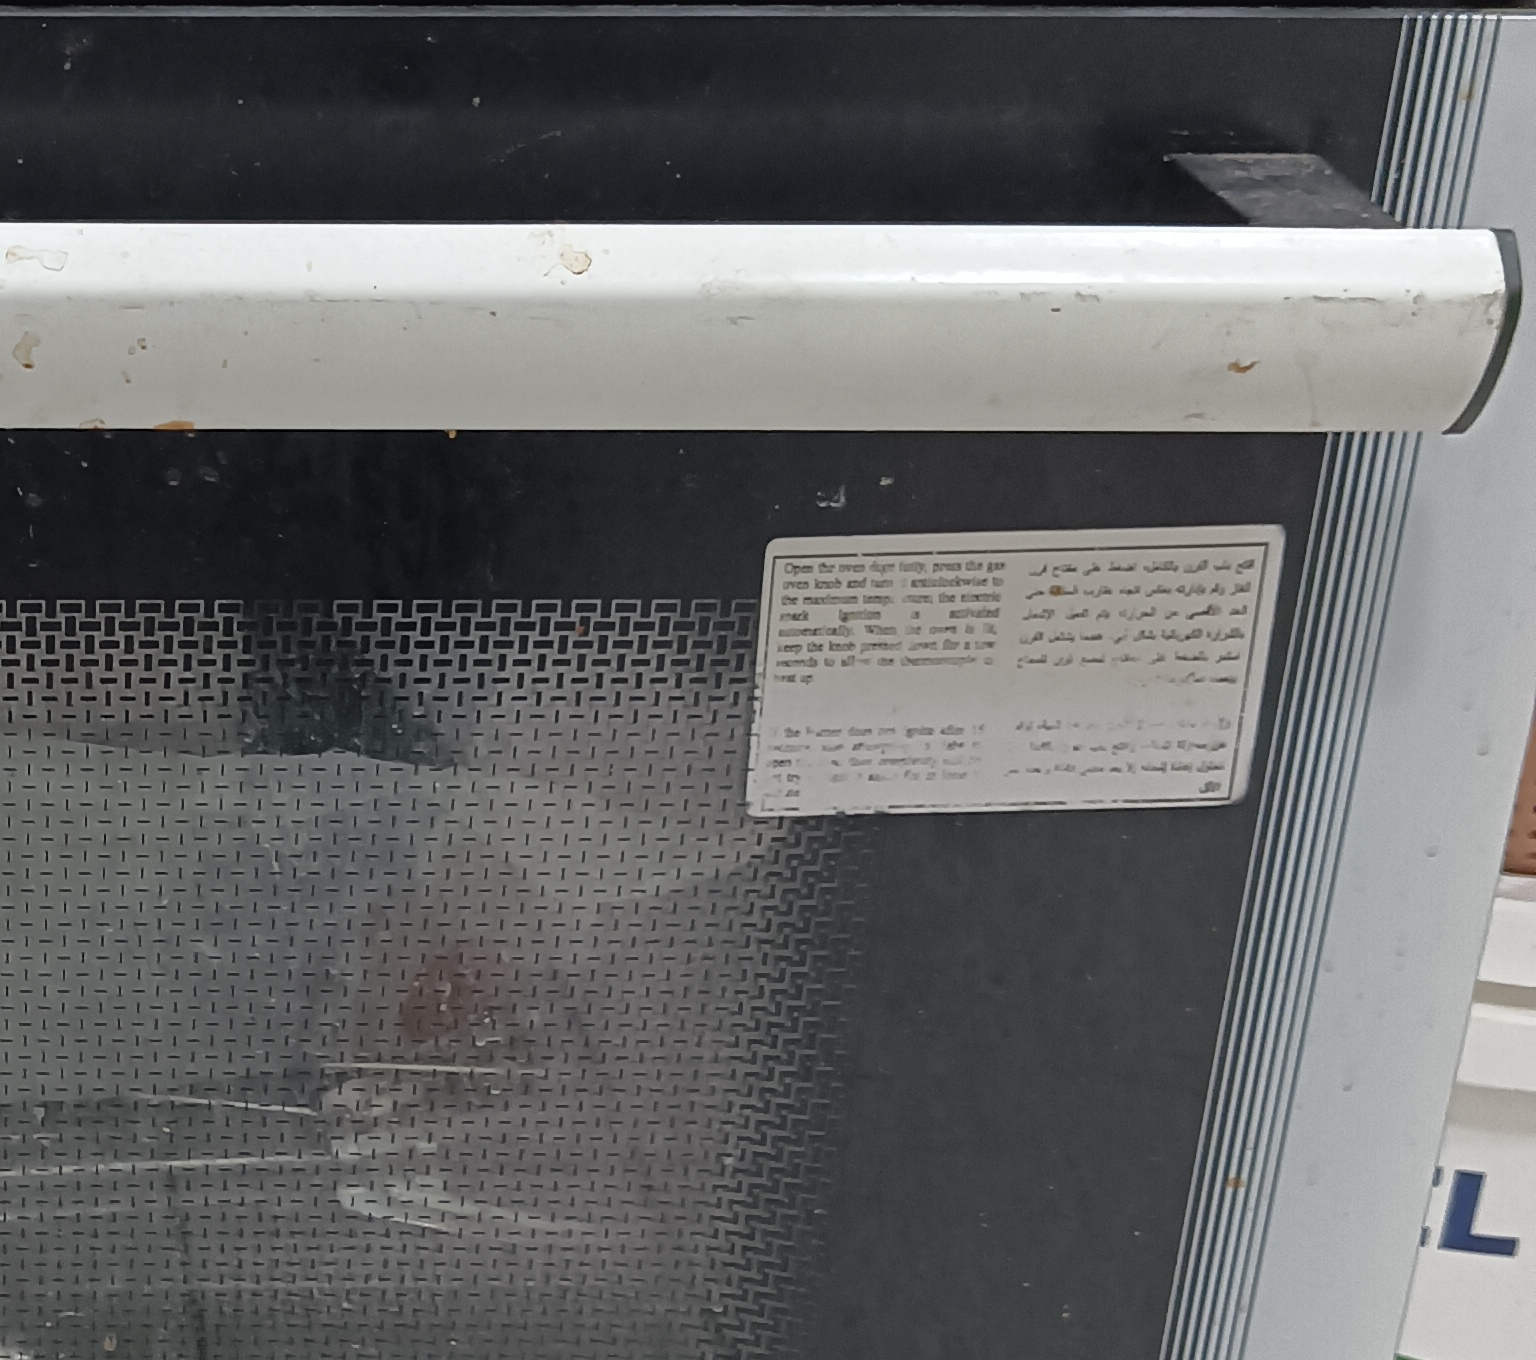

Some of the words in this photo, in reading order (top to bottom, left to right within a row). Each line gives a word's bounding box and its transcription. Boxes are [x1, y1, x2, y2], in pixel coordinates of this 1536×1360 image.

[784, 562, 814, 577] Open
[817, 561, 836, 574] the
[838, 563, 866, 573] oven
[931, 562, 963, 574] press
[965, 560, 984, 572] the
[782, 580, 810, 590] oven
[814, 577, 843, 590] knob
[846, 576, 868, 589] and
[780, 594, 799, 606] the
[802, 593, 859, 606] maximum
[937, 591, 956, 604] the
[806, 640, 825, 653] the
[827, 639, 857, 652] knob
